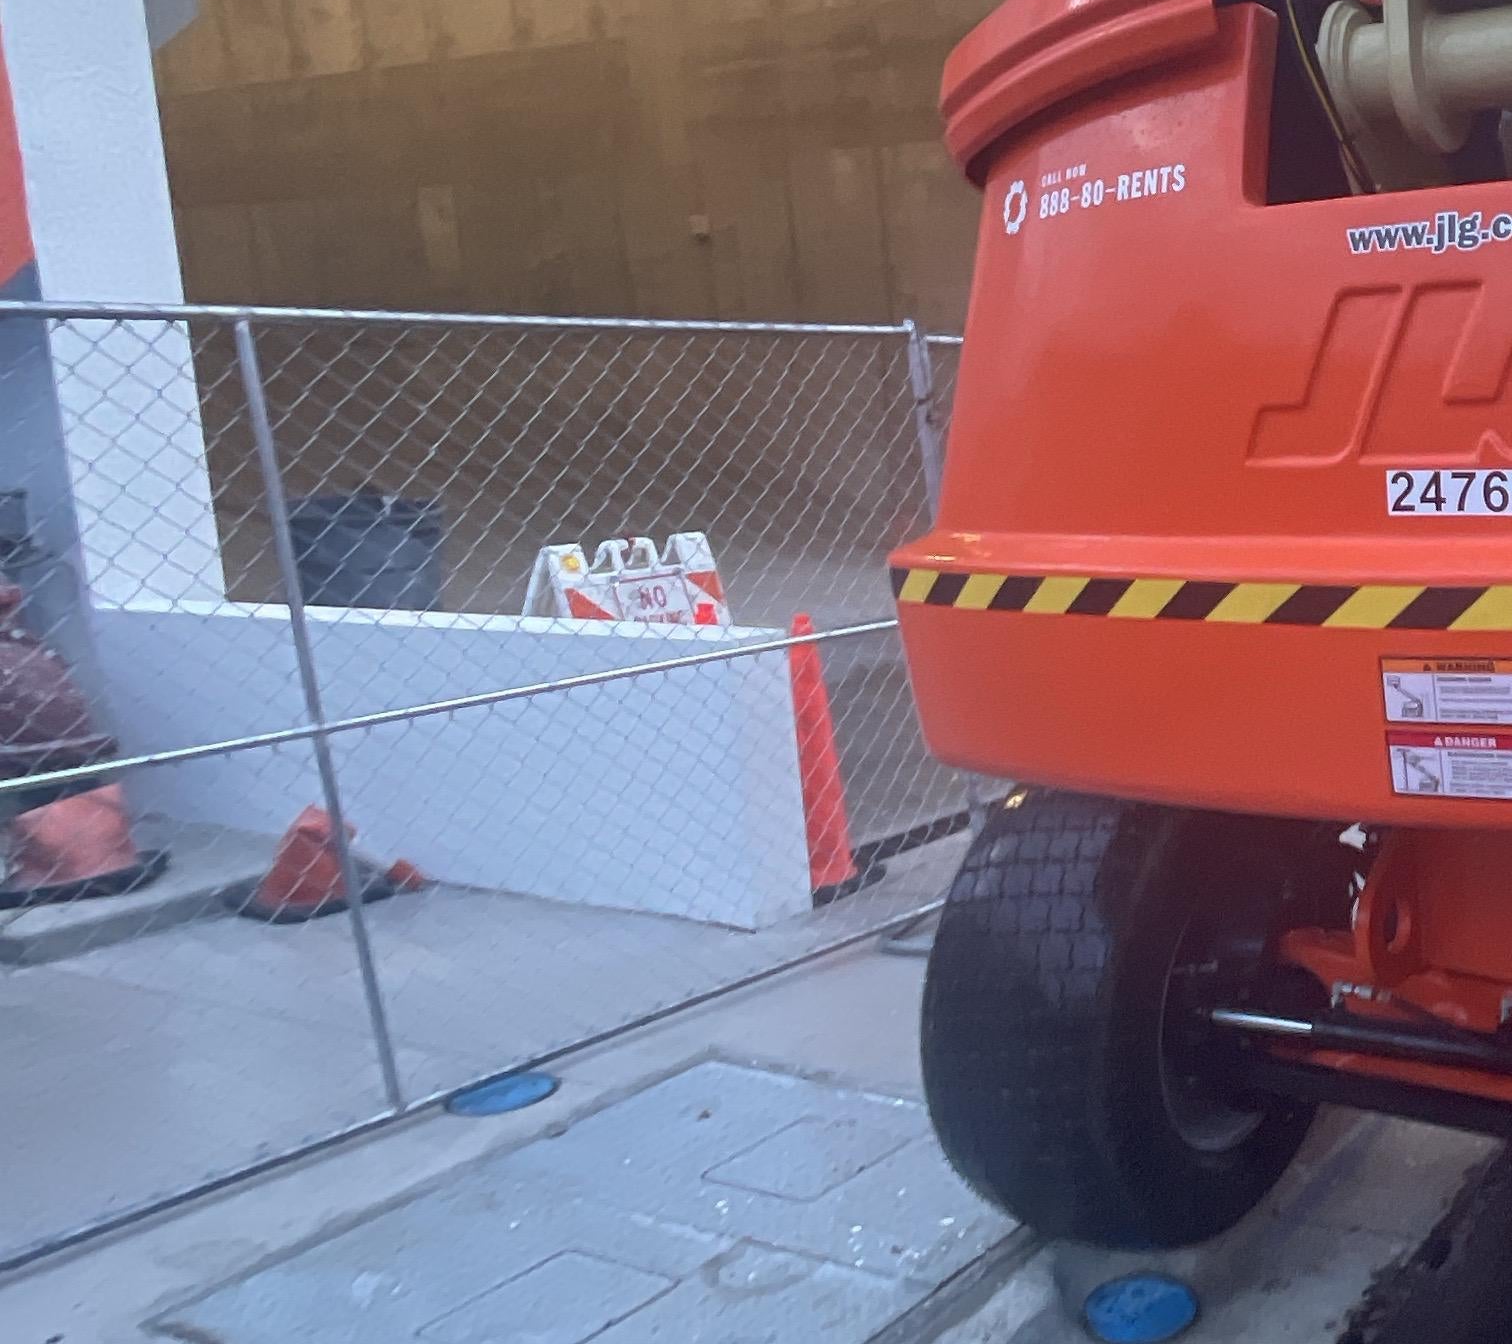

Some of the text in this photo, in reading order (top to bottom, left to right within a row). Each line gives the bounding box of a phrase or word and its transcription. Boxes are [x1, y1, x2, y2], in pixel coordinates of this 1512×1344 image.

[1041, 163, 1087, 188] CALL NOW
[1039, 164, 1186, 219] 888-80-RENTS
[1445, 737, 1497, 748] DANGER
